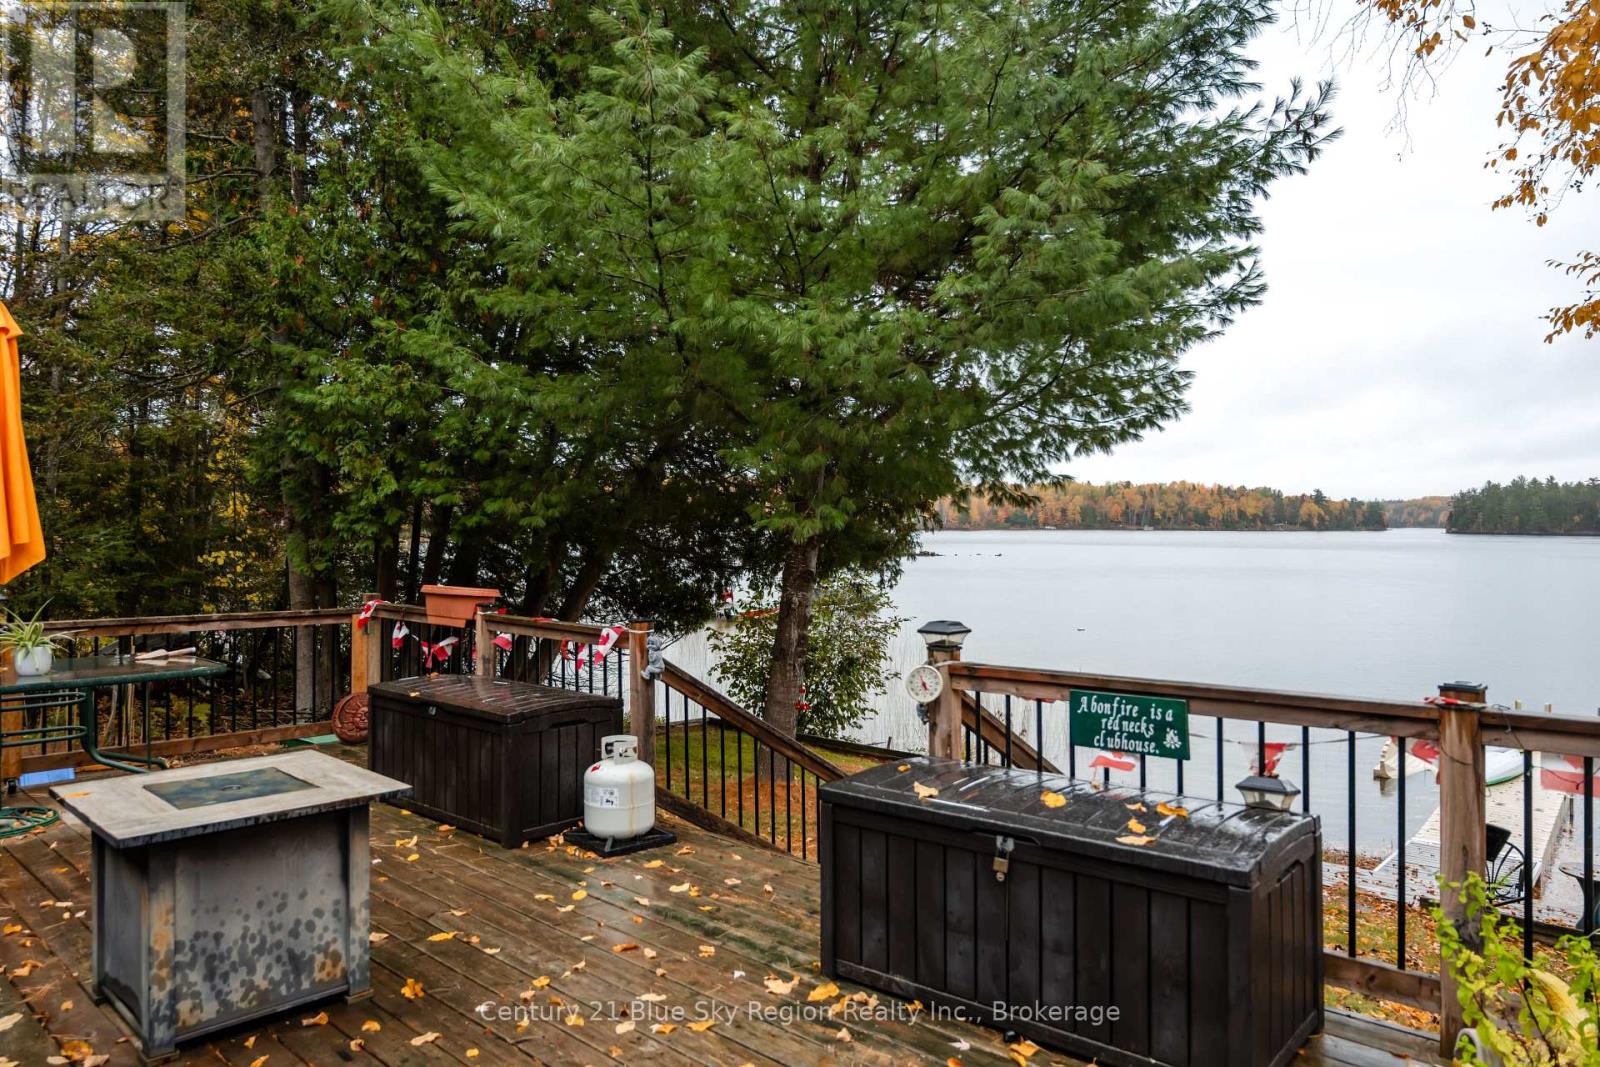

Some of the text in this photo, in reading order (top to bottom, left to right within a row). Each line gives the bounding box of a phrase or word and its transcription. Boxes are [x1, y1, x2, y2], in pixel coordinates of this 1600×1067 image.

[1090, 695, 1139, 720] bonfire
[1150, 703, 1162, 720] is
[1165, 708, 1174, 722] a
[1093, 730, 1160, 754] clubhouse.
